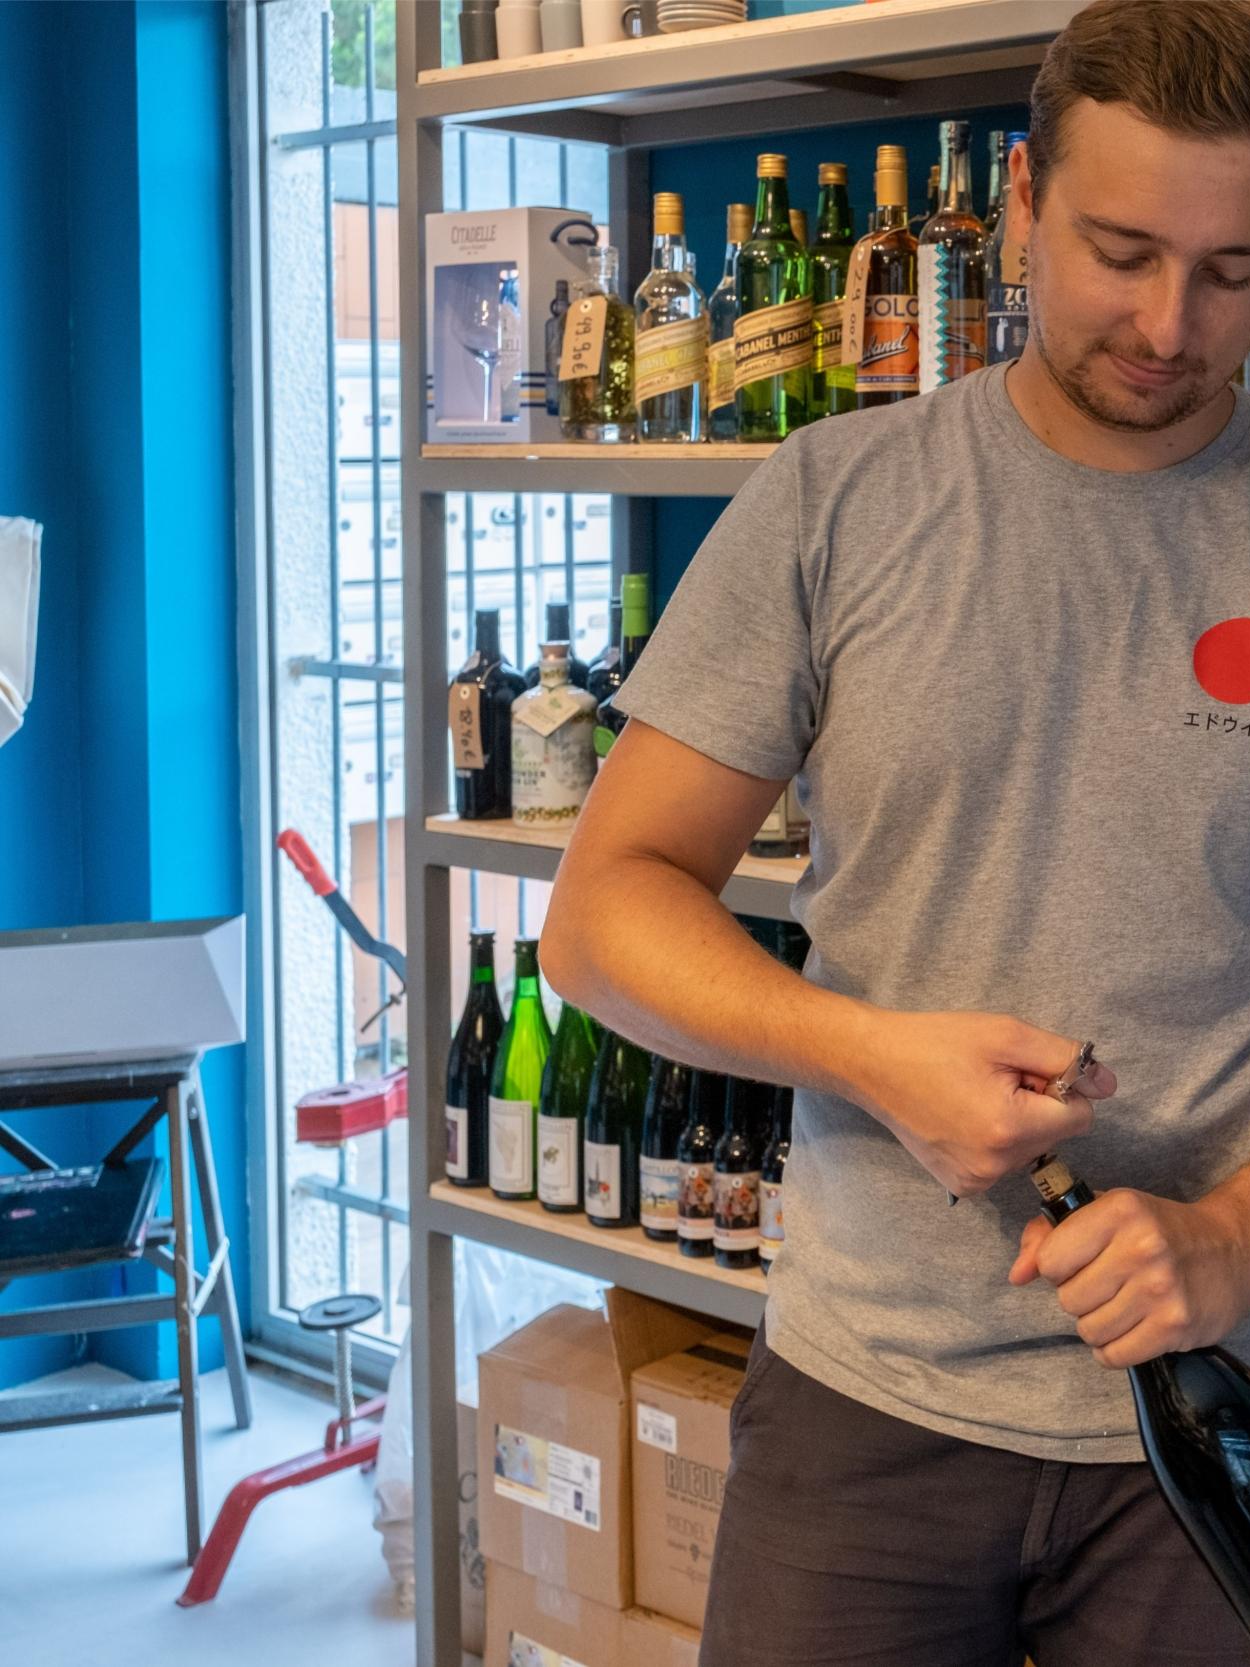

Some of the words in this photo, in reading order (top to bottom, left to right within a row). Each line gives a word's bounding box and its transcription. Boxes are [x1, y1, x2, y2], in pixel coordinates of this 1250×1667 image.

[450, 225, 497, 245] CITADELLE
[735, 334, 777, 361] CABANEL
[1037, 1177, 1060, 1201] TH
